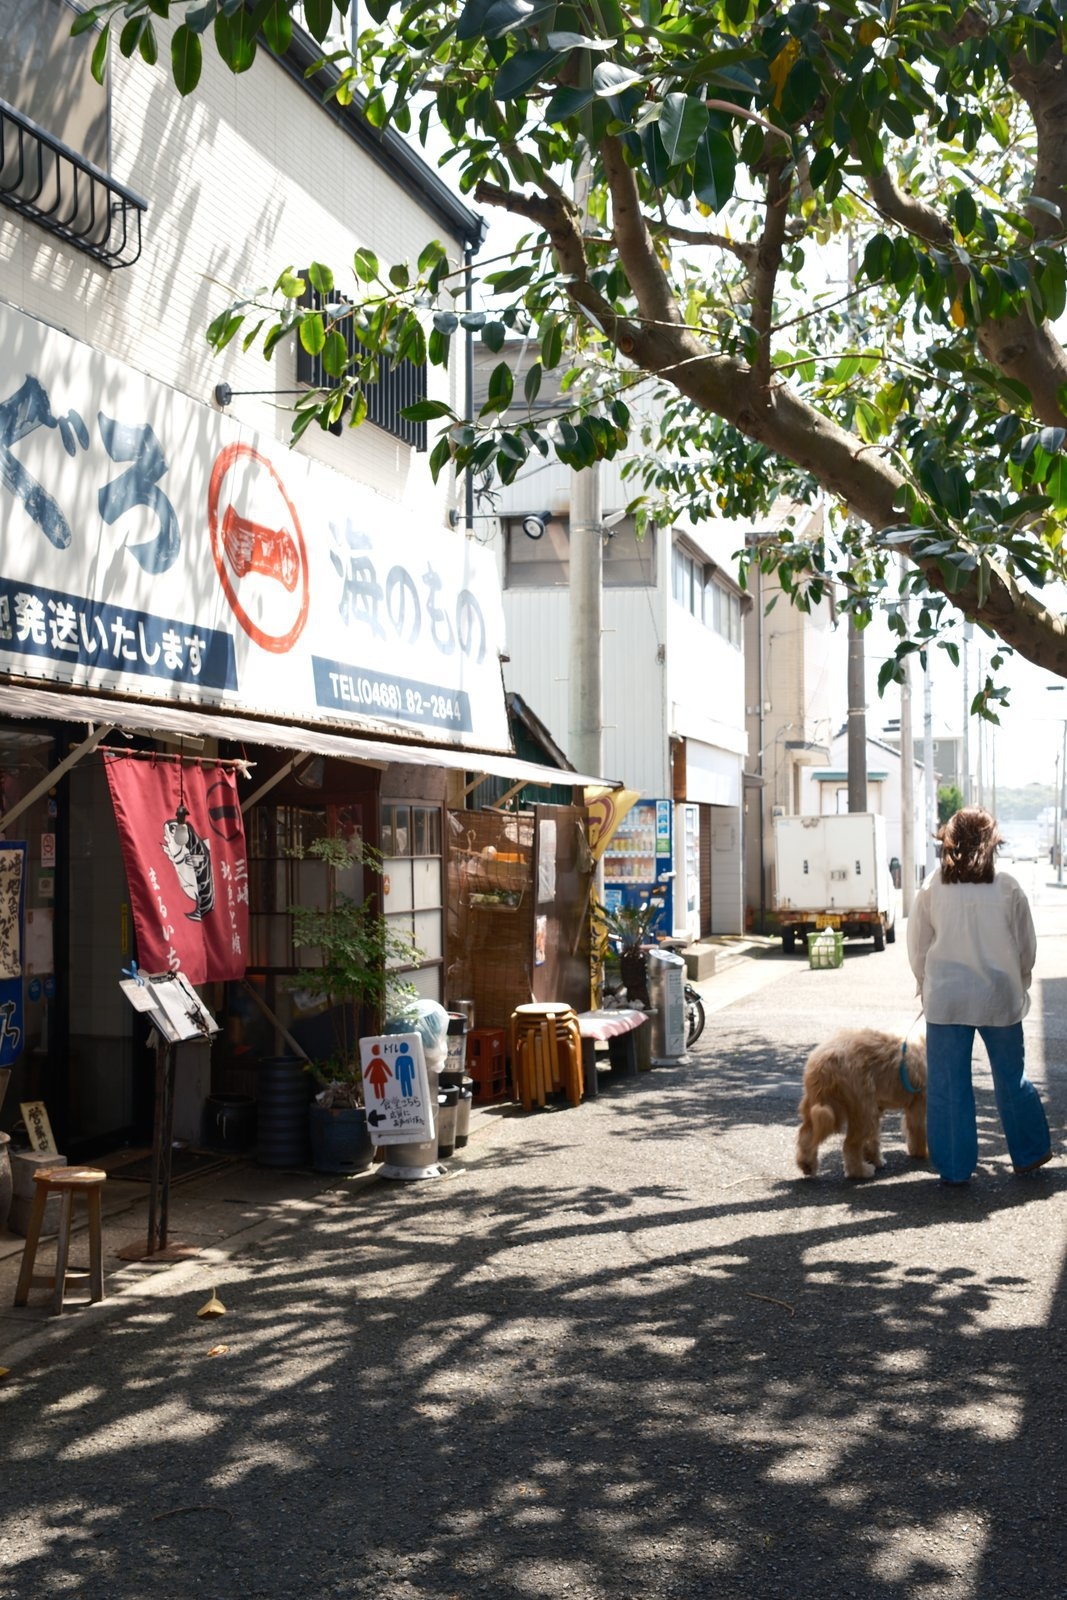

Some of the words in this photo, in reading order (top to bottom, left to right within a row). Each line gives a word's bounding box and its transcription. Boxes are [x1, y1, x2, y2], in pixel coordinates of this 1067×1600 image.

[328, 517, 487, 665] 海のもの
[329, 673, 401, 711] TEL(0468)
[405, 688, 461, 721] 82-2844
[148, 867, 181, 972] まるいち
[384, 1043, 399, 1054] トイレ
[28, 1106, 49, 1151] 営業中
